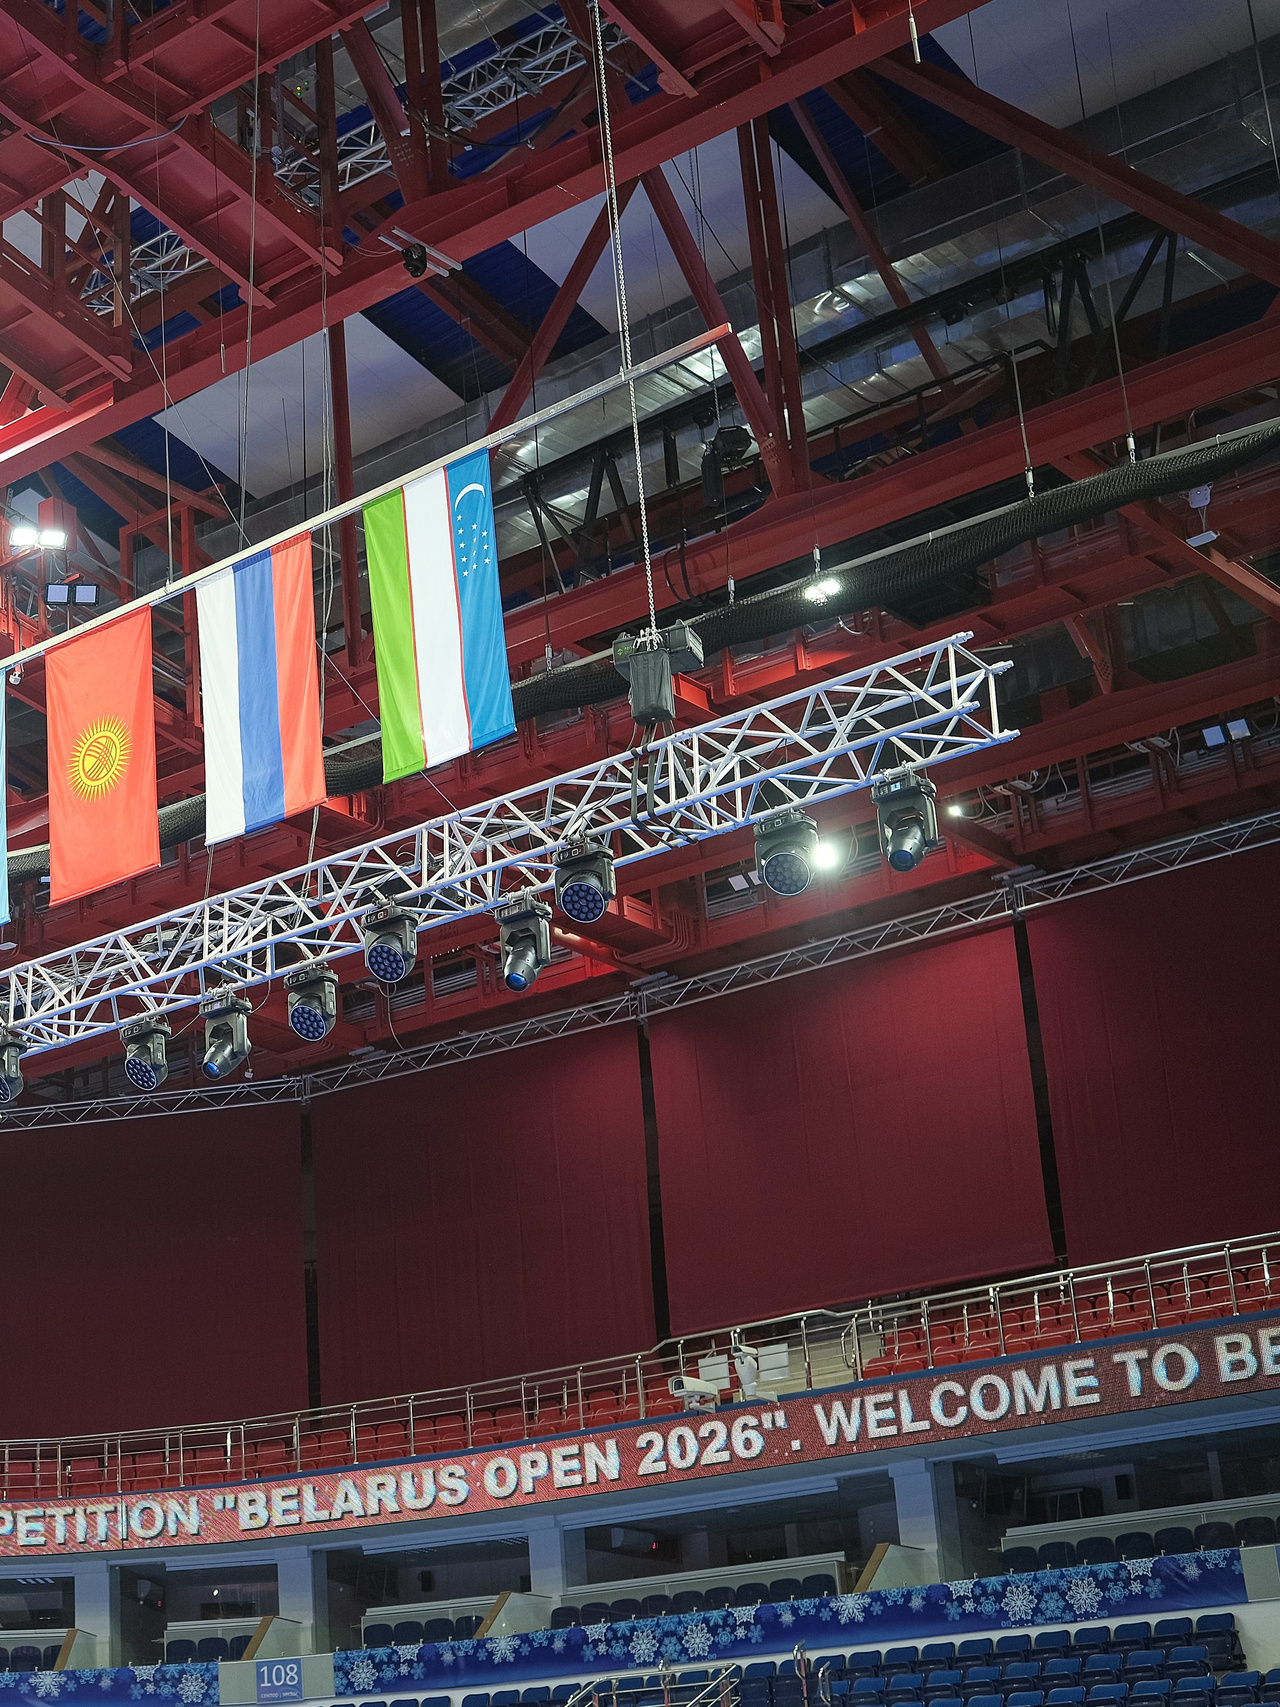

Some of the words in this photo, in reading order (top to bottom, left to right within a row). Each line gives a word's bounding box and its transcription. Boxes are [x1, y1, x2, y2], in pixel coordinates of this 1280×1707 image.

[214, 1464, 471, 1531] "BELARUS
[483, 1438, 621, 1500] OPEN
[814, 1358, 1101, 1446] WELCOME
[1113, 1342, 1201, 1398] TO
[260, 1663, 298, 1687] 108
